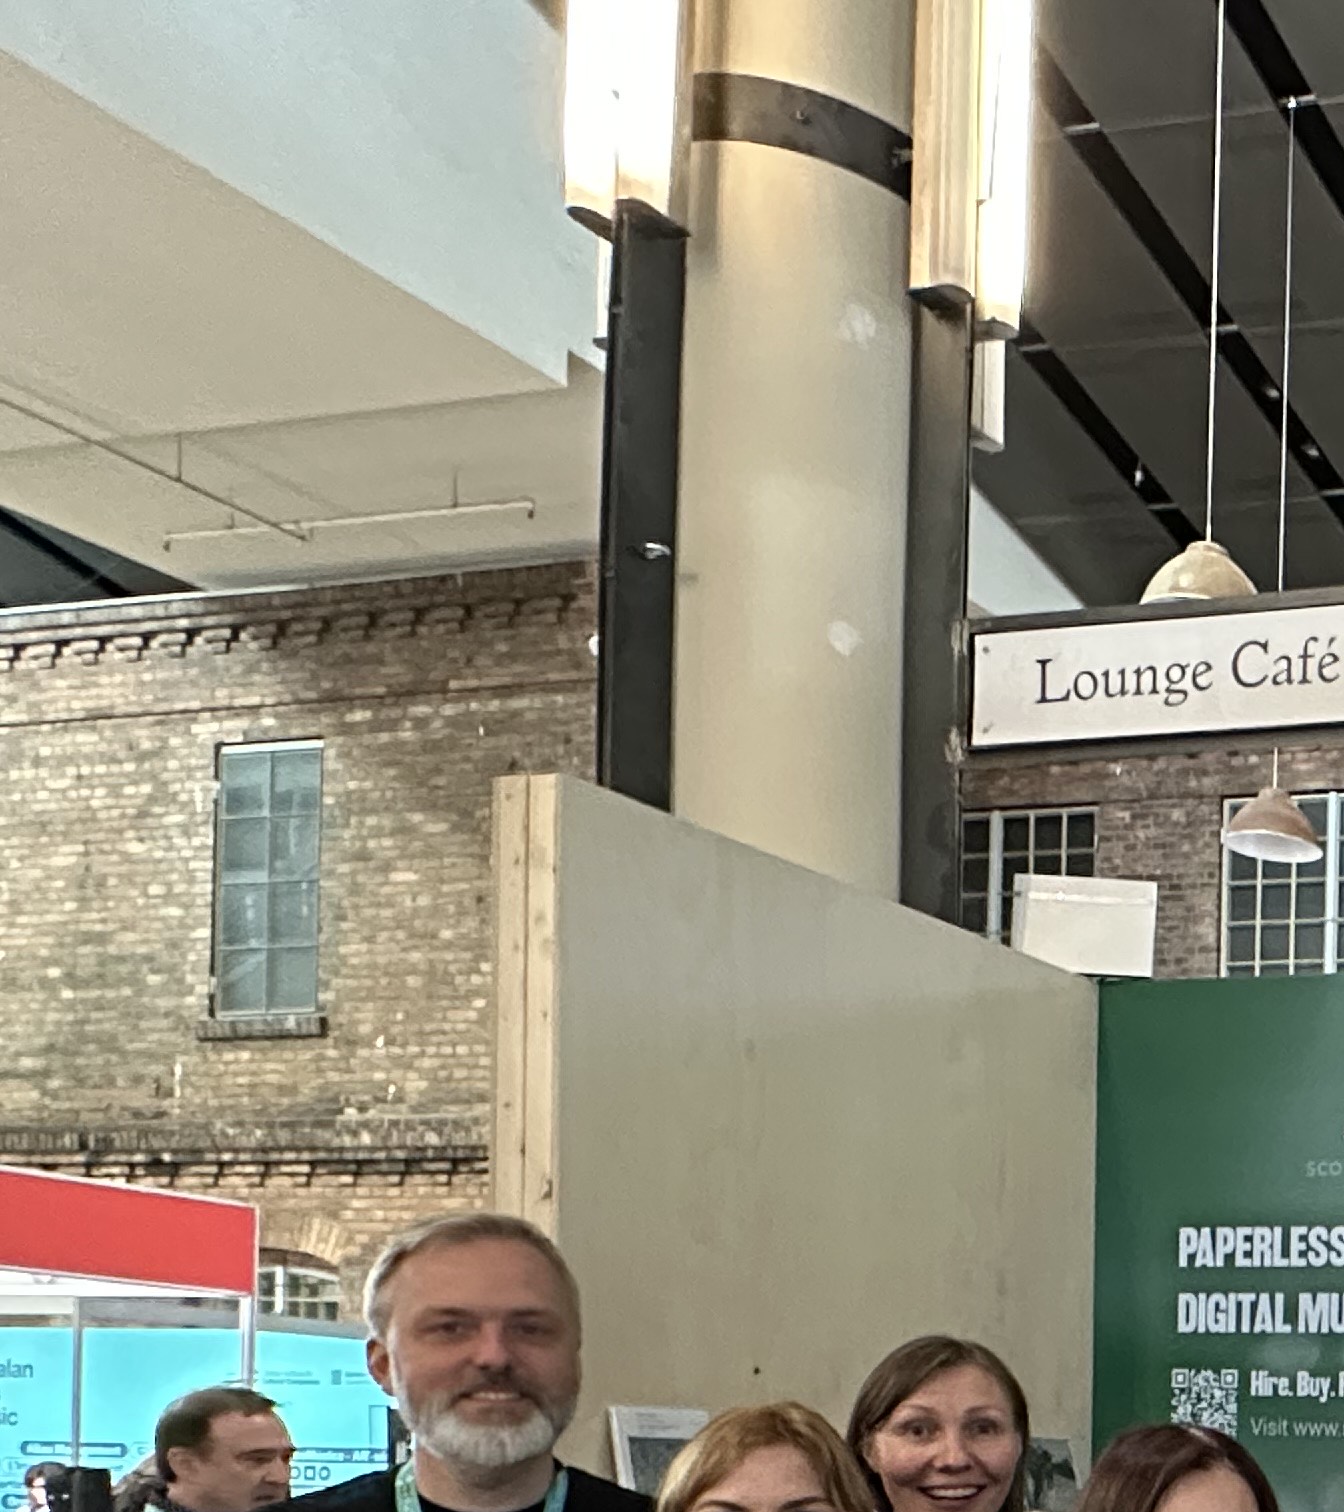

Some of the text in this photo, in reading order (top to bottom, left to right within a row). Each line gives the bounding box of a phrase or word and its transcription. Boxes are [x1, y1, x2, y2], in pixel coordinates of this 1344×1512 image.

[1035, 635, 1342, 706] Lounge Café
[1177, 1293, 1290, 1335] DIGITAL
[1250, 1371, 1294, 1398] Hire.
[1296, 1370, 1335, 1403] Buy.
[1250, 1416, 1289, 1438] Visit
